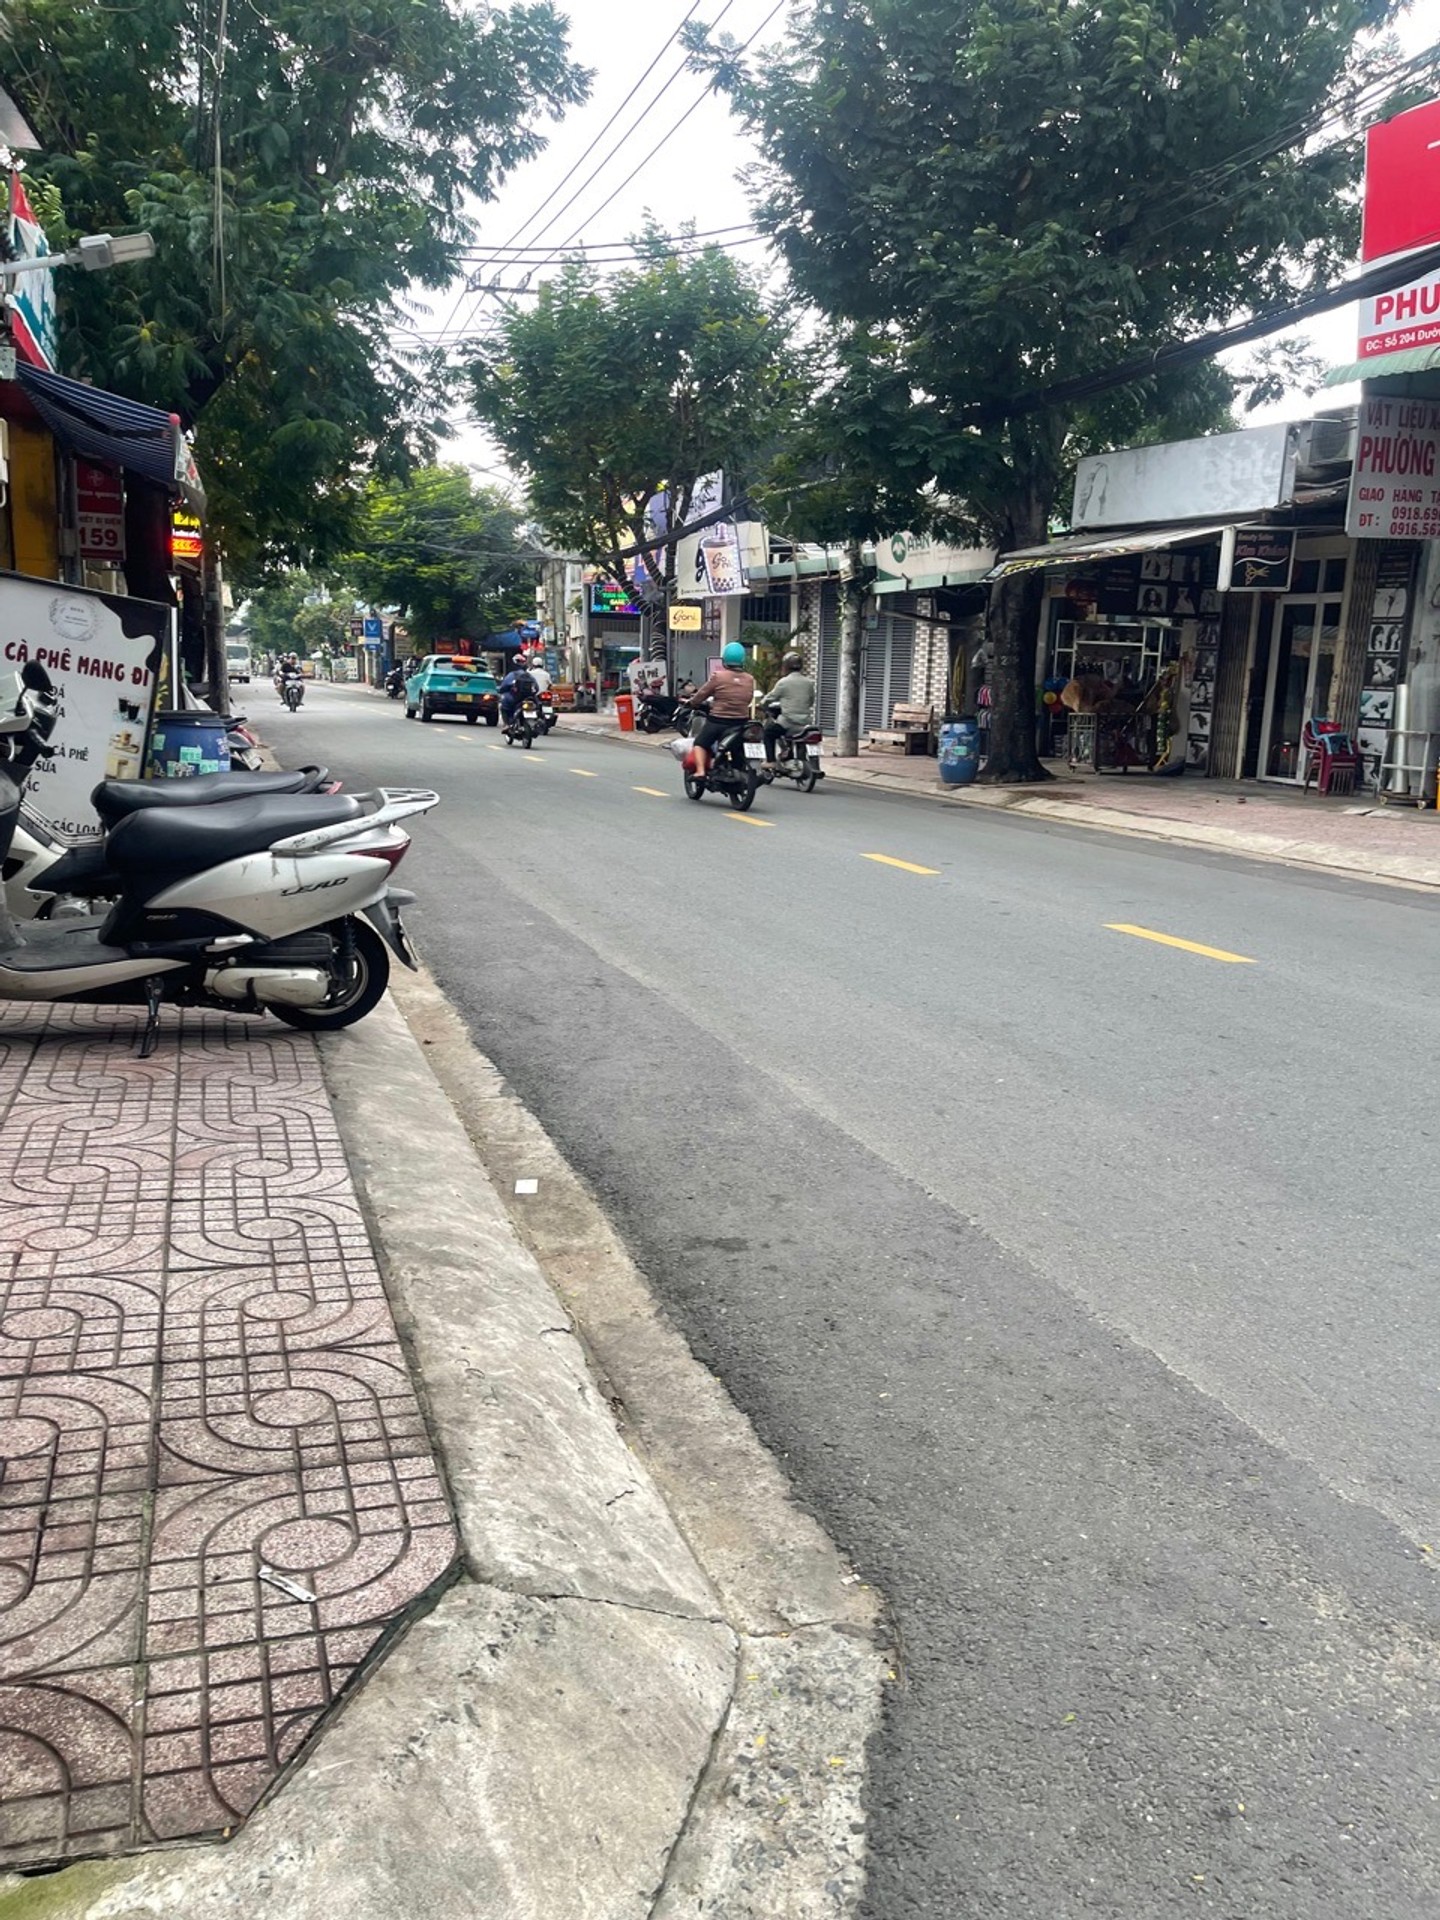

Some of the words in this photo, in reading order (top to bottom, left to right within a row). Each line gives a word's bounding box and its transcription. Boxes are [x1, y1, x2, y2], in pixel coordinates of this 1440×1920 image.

[1399, 332, 1416, 345] 204
[1367, 402, 1392, 429] VẬT
[1359, 487, 1385, 501] GIAO
[1392, 484, 1423, 503] HÀNG
[79, 527, 118, 548] 159
[4, 638, 29, 664] CÀ
[35, 648, 72, 672] PHÊ
[77, 655, 125, 682] MANG
[131, 666, 149, 687] ĐI
[69, 747, 89, 761] PHÊ
